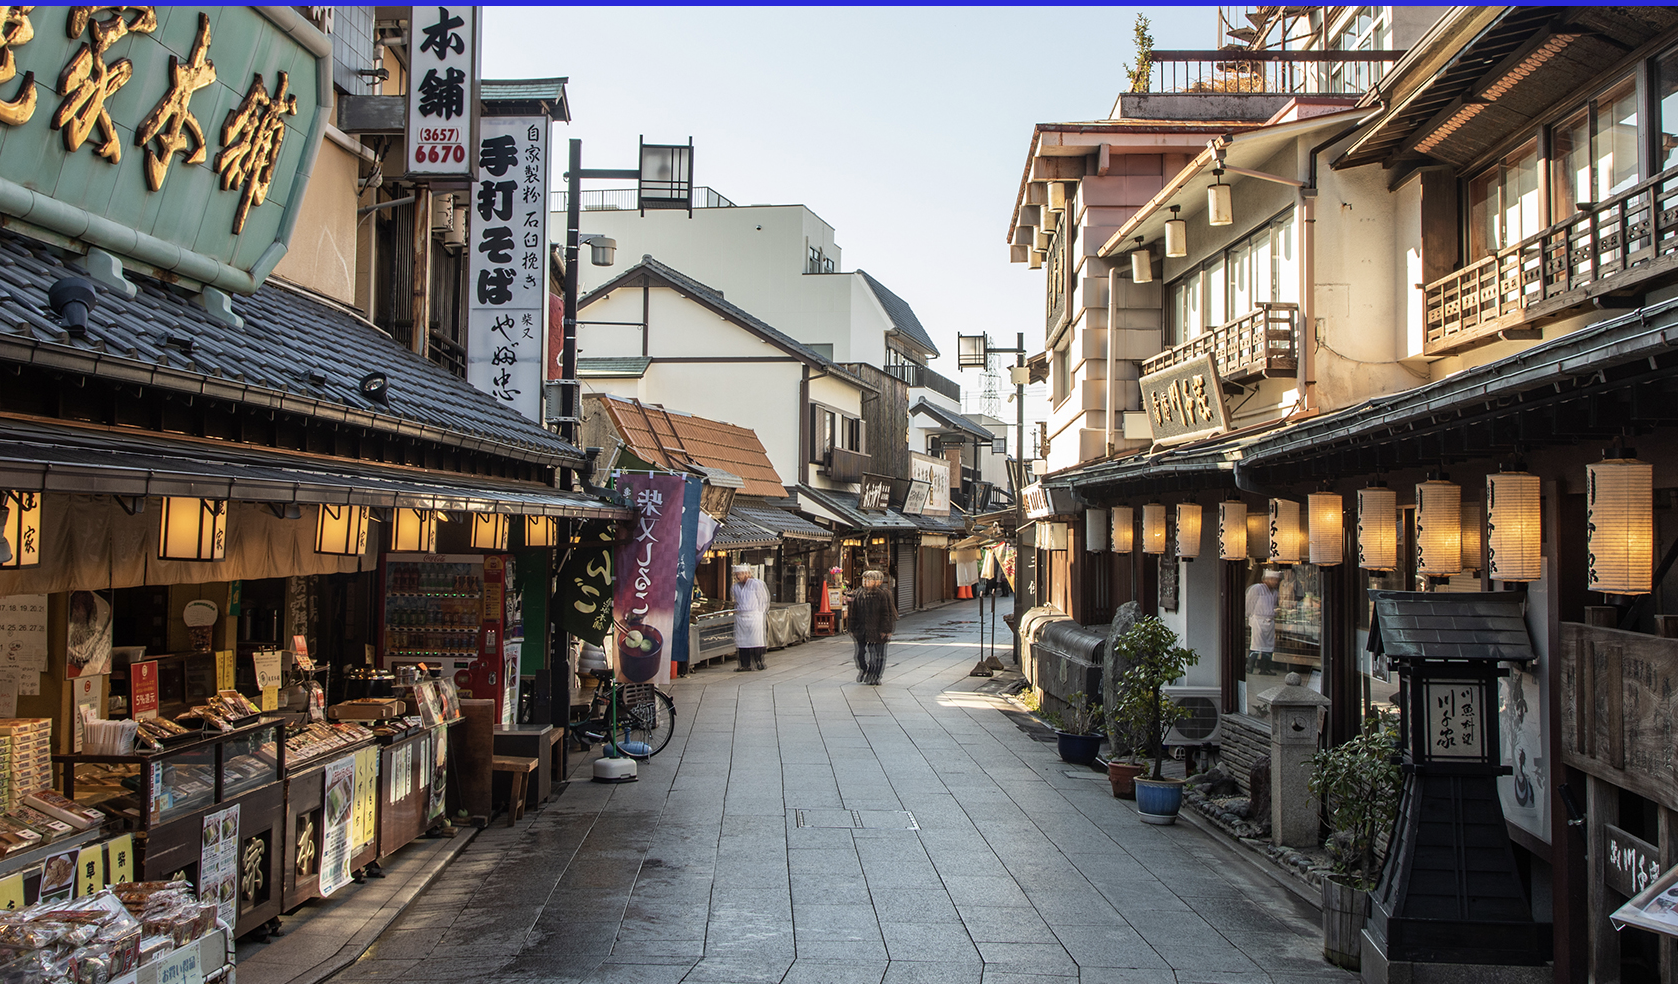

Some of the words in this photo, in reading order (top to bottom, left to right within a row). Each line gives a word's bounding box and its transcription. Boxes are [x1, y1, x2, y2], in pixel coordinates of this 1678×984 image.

[418, 7, 466, 121] 本舗
[415, 145, 465, 164] 6670
[420, 127, 460, 142] (3657)
[521, 124, 542, 205] 自家製粉
[477, 133, 519, 306] 手打そば
[519, 211, 541, 291] 石臼挽き
[521, 313, 534, 340] 柴又
[632, 489, 664, 616] 柴又しるこ
[1436, 689, 1457, 750] 川千家
[1460, 687, 1476, 746] 川魚料理
